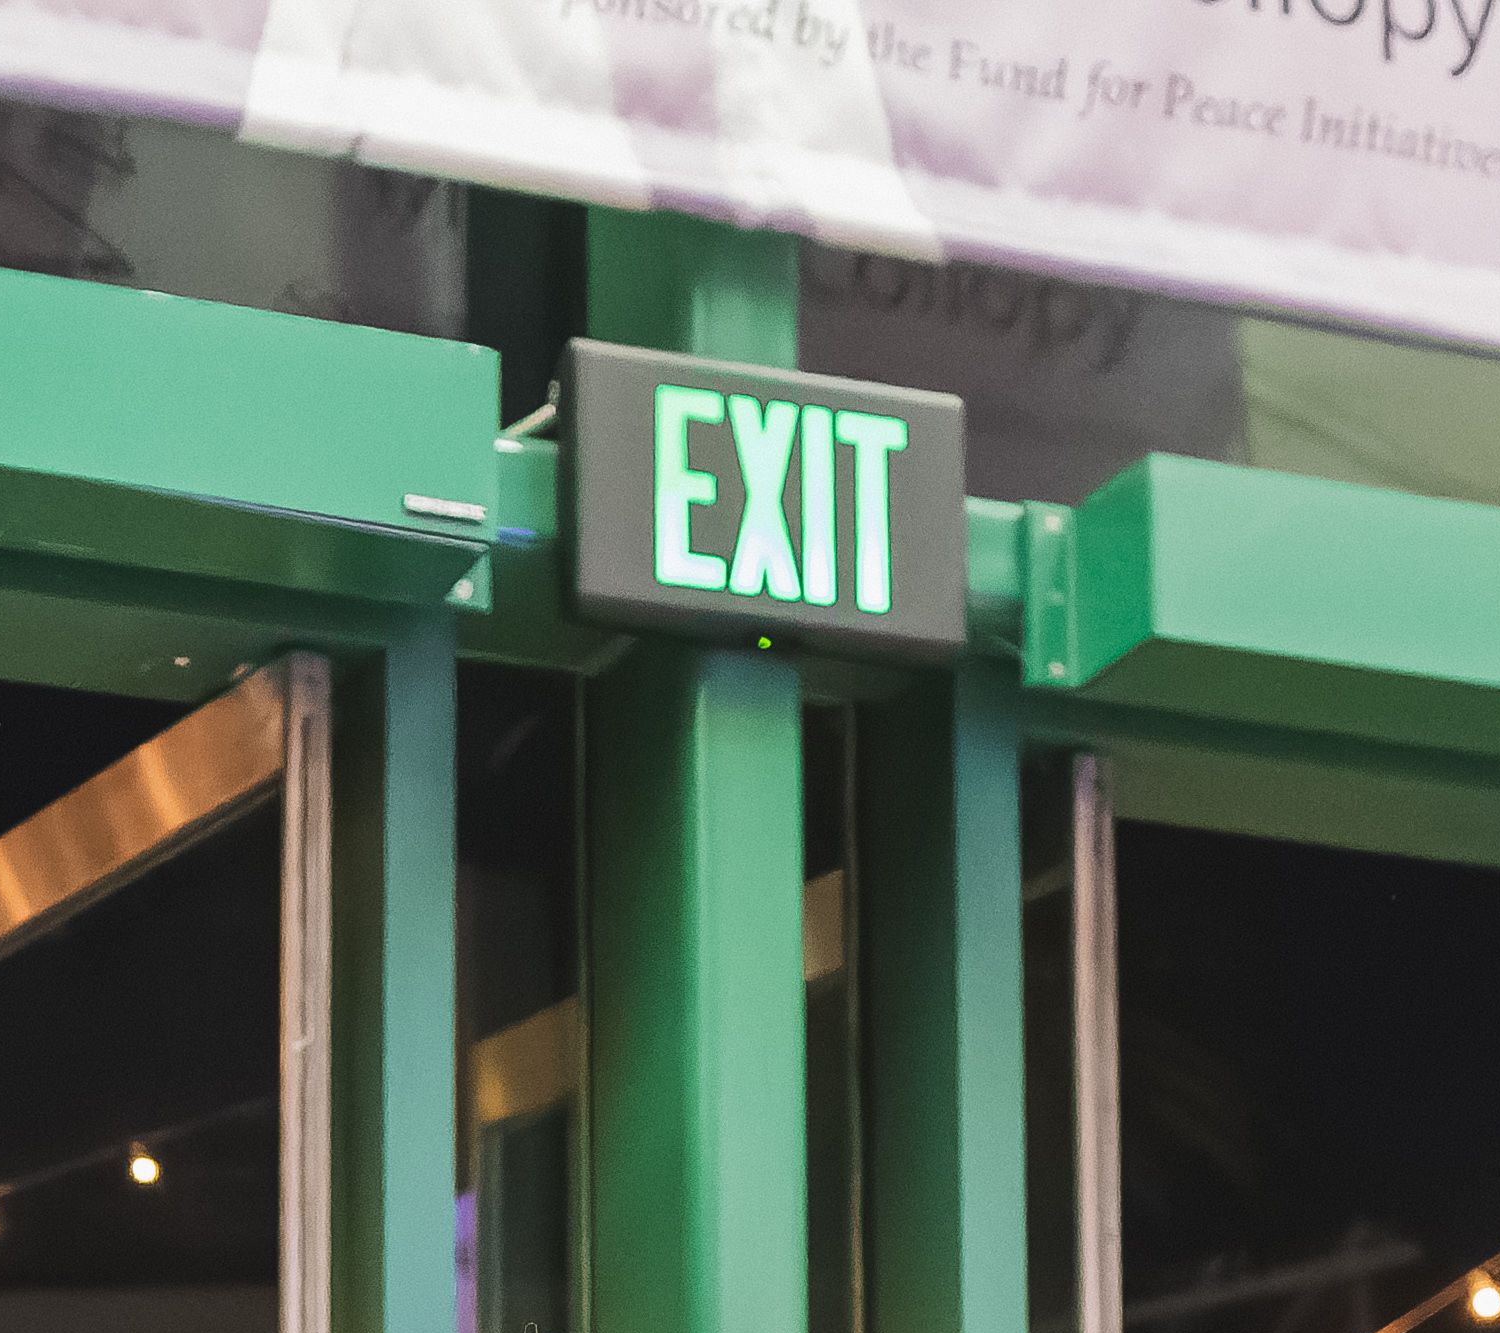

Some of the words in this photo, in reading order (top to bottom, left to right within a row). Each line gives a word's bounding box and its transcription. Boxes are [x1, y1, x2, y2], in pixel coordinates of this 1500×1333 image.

[794, 8, 852, 69] by
[867, 16, 934, 74] the
[948, 37, 1069, 101] Fund
[1078, 58, 1152, 117] for
[1162, 71, 1288, 138] Peace
[654, 384, 908, 614] EXIT
